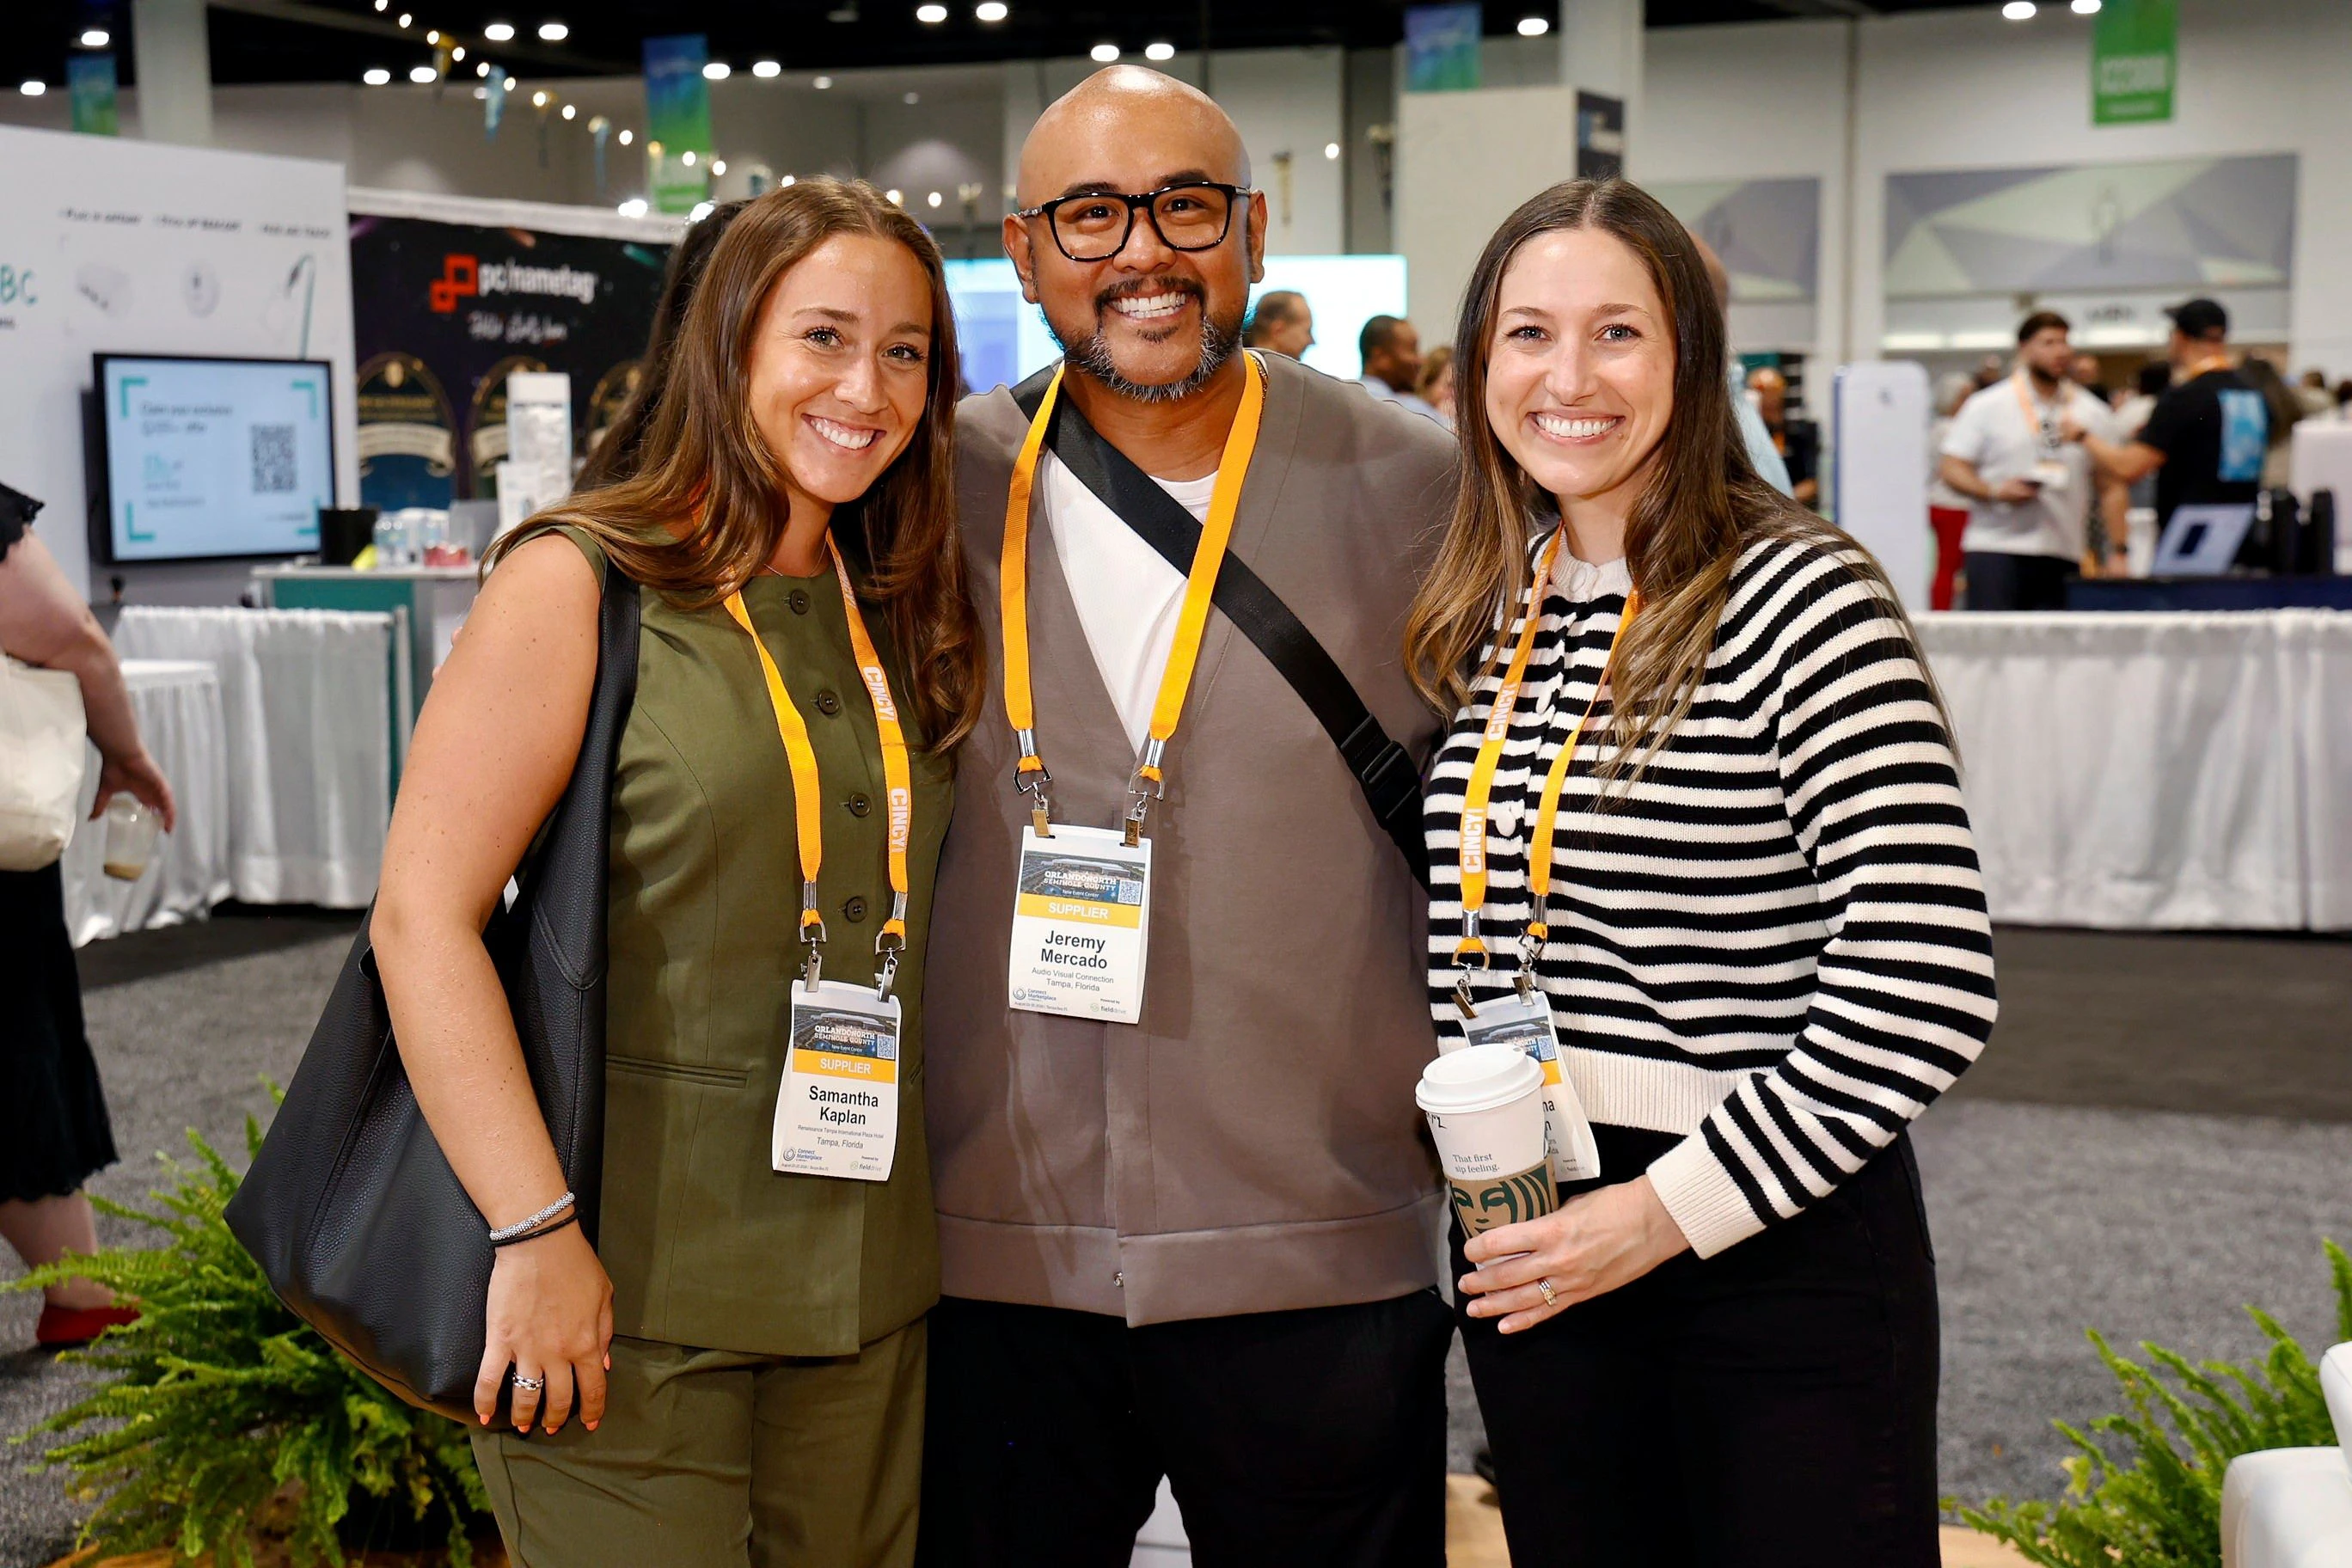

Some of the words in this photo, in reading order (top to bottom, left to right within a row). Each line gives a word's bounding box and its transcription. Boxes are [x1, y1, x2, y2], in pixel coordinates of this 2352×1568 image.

[1043, 878, 1082, 888] SEMINOLE
[1084, 882, 1117, 891] COUNTY
[1048, 902, 1109, 920] SUPPLIER
[1045, 930, 1106, 953] Jeremy
[1041, 948, 1107, 969] Mercado
[1032, 967, 1051, 976] Audio
[1053, 970, 1074, 978] Visual
[1075, 973, 1114, 983] Connection
[1047, 978, 1073, 989] Tampa,
[1075, 982, 1099, 991] Florida
[814, 1032, 848, 1043] SEMINOLE
[849, 1037, 875, 1046] COUNTY
[820, 1058, 871, 1075] SUPPLIER
[809, 1086, 879, 1107] Samantha
[820, 1106, 866, 1125] Kaplan
[817, 1137, 840, 1148] Tampa,
[842, 1140, 864, 1149] Florida
[1453, 1155, 1472, 1163] That
[1473, 1154, 1492, 1162] first
[1468, 1164, 1499, 1173] feeling.
